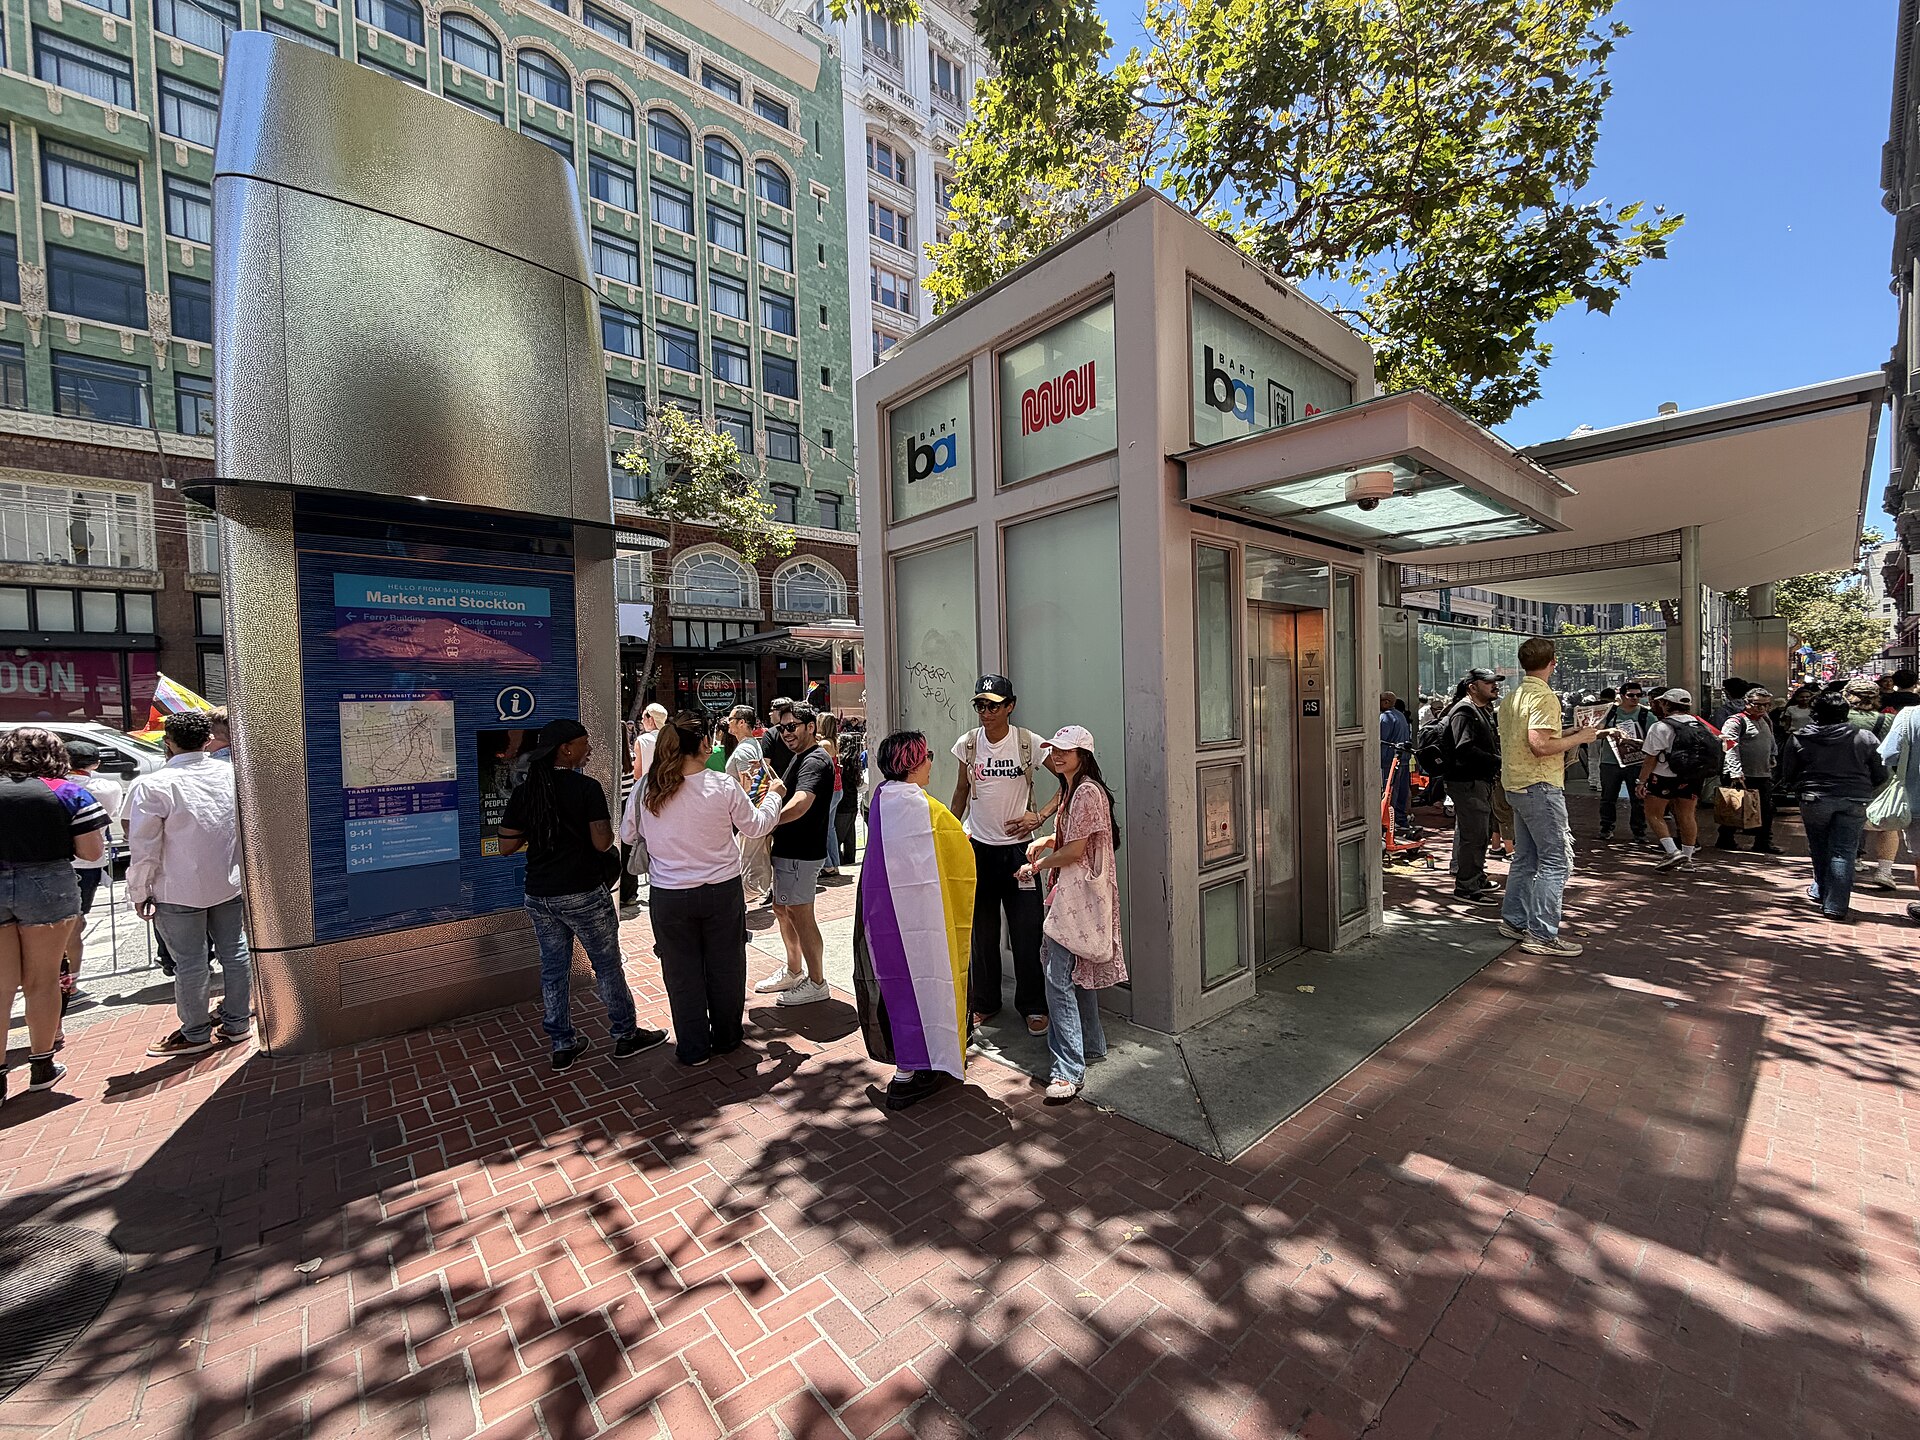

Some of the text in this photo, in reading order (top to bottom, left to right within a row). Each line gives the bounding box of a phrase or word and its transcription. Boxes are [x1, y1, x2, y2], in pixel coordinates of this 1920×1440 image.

[1219, 353, 1255, 379] BART
[920, 418, 956, 441] BART
[366, 590, 526, 611] Market and Stockton
[363, 613, 427, 624] Ferry Building
[509, 620, 527, 628] Park
[986, 757, 1015, 768] I am
[484, 799, 508, 808] PEOPLE
[487, 816, 503, 825] WOR
[349, 829, 372, 838] 9-1-1
[350, 843, 373, 852] 5-1-1
[351, 857, 373, 866] 3-1-1
